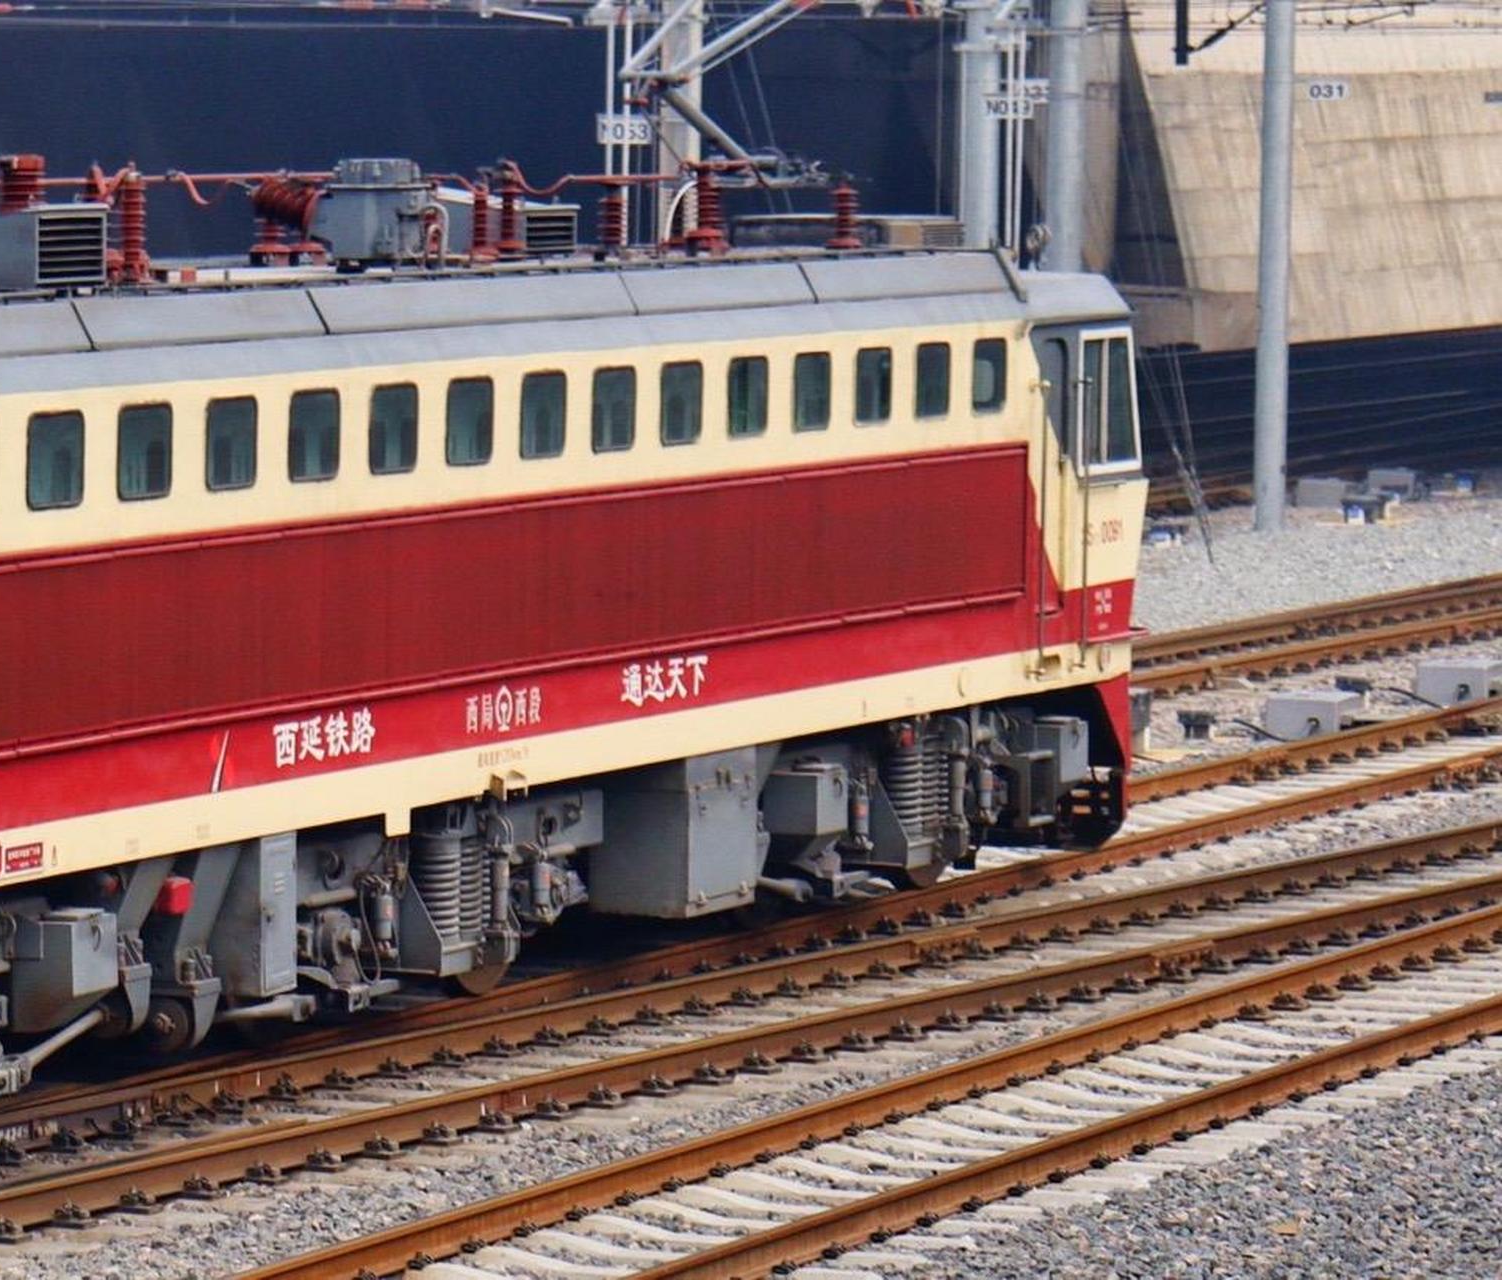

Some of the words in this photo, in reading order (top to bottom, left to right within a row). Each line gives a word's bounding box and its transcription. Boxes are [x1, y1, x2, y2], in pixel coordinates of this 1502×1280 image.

[1309, 84, 1345, 99] 031
[620, 654, 709, 708] 通达天下
[272, 706, 376, 769] 西延铁路
